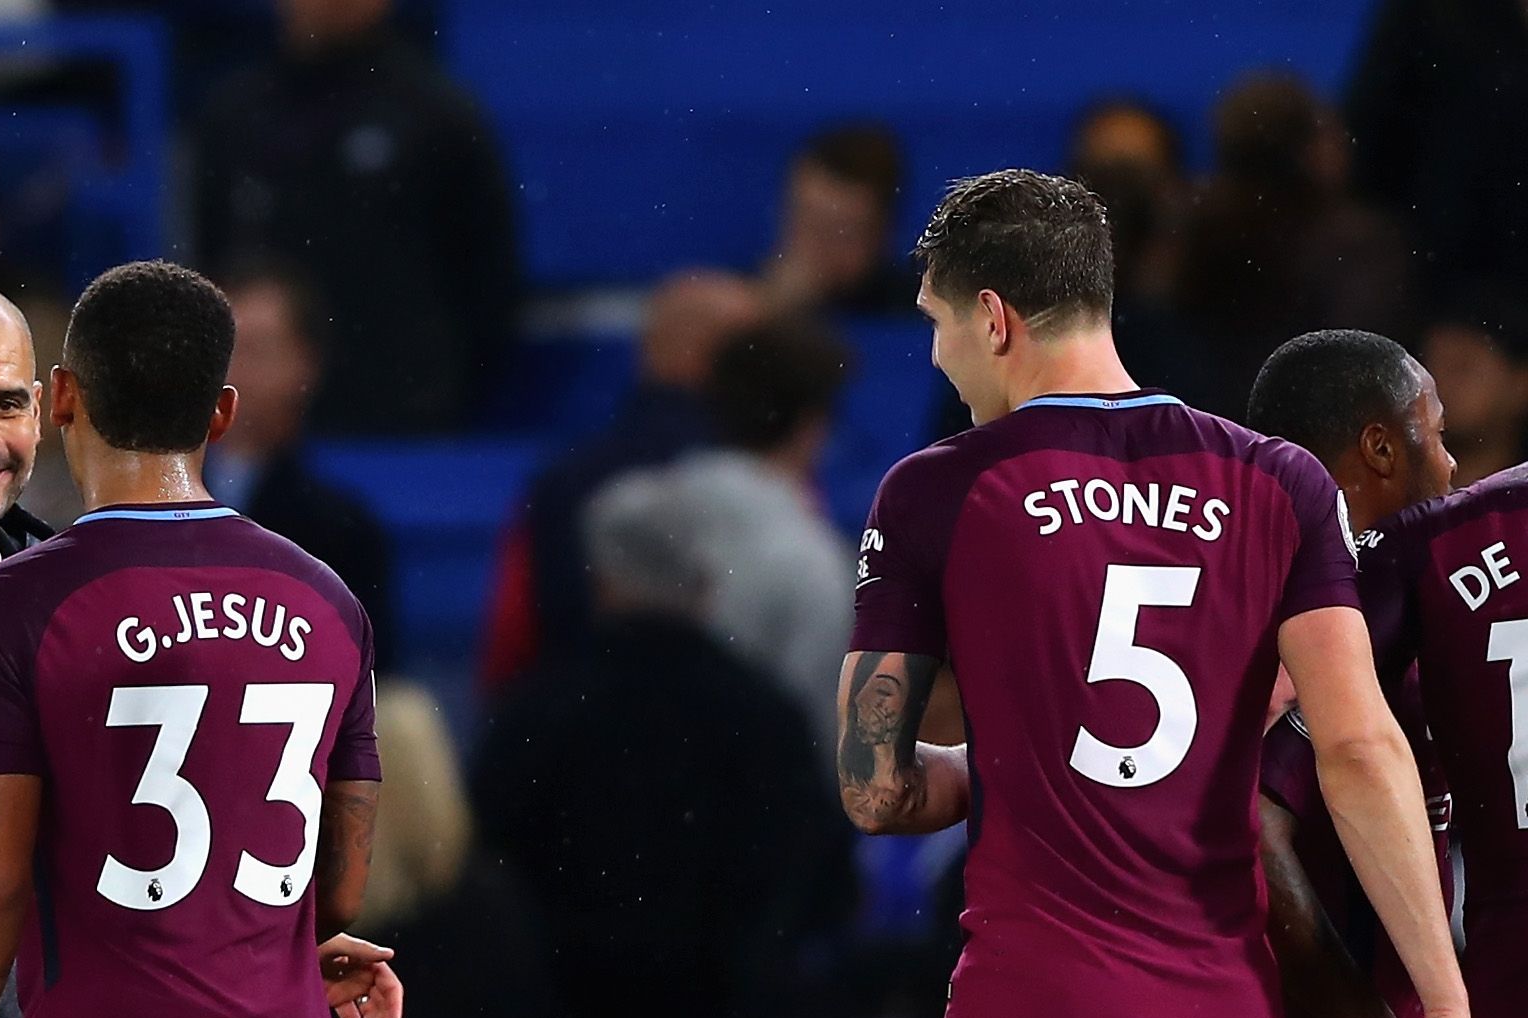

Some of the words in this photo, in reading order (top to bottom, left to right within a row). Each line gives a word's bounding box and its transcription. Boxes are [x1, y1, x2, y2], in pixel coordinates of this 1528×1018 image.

[1024, 478, 1230, 541] STONES
[1448, 541, 1521, 612] DE
[116, 592, 312, 663] G.JESUS
[1069, 564, 1202, 788] 5
[96, 683, 335, 910] 33
